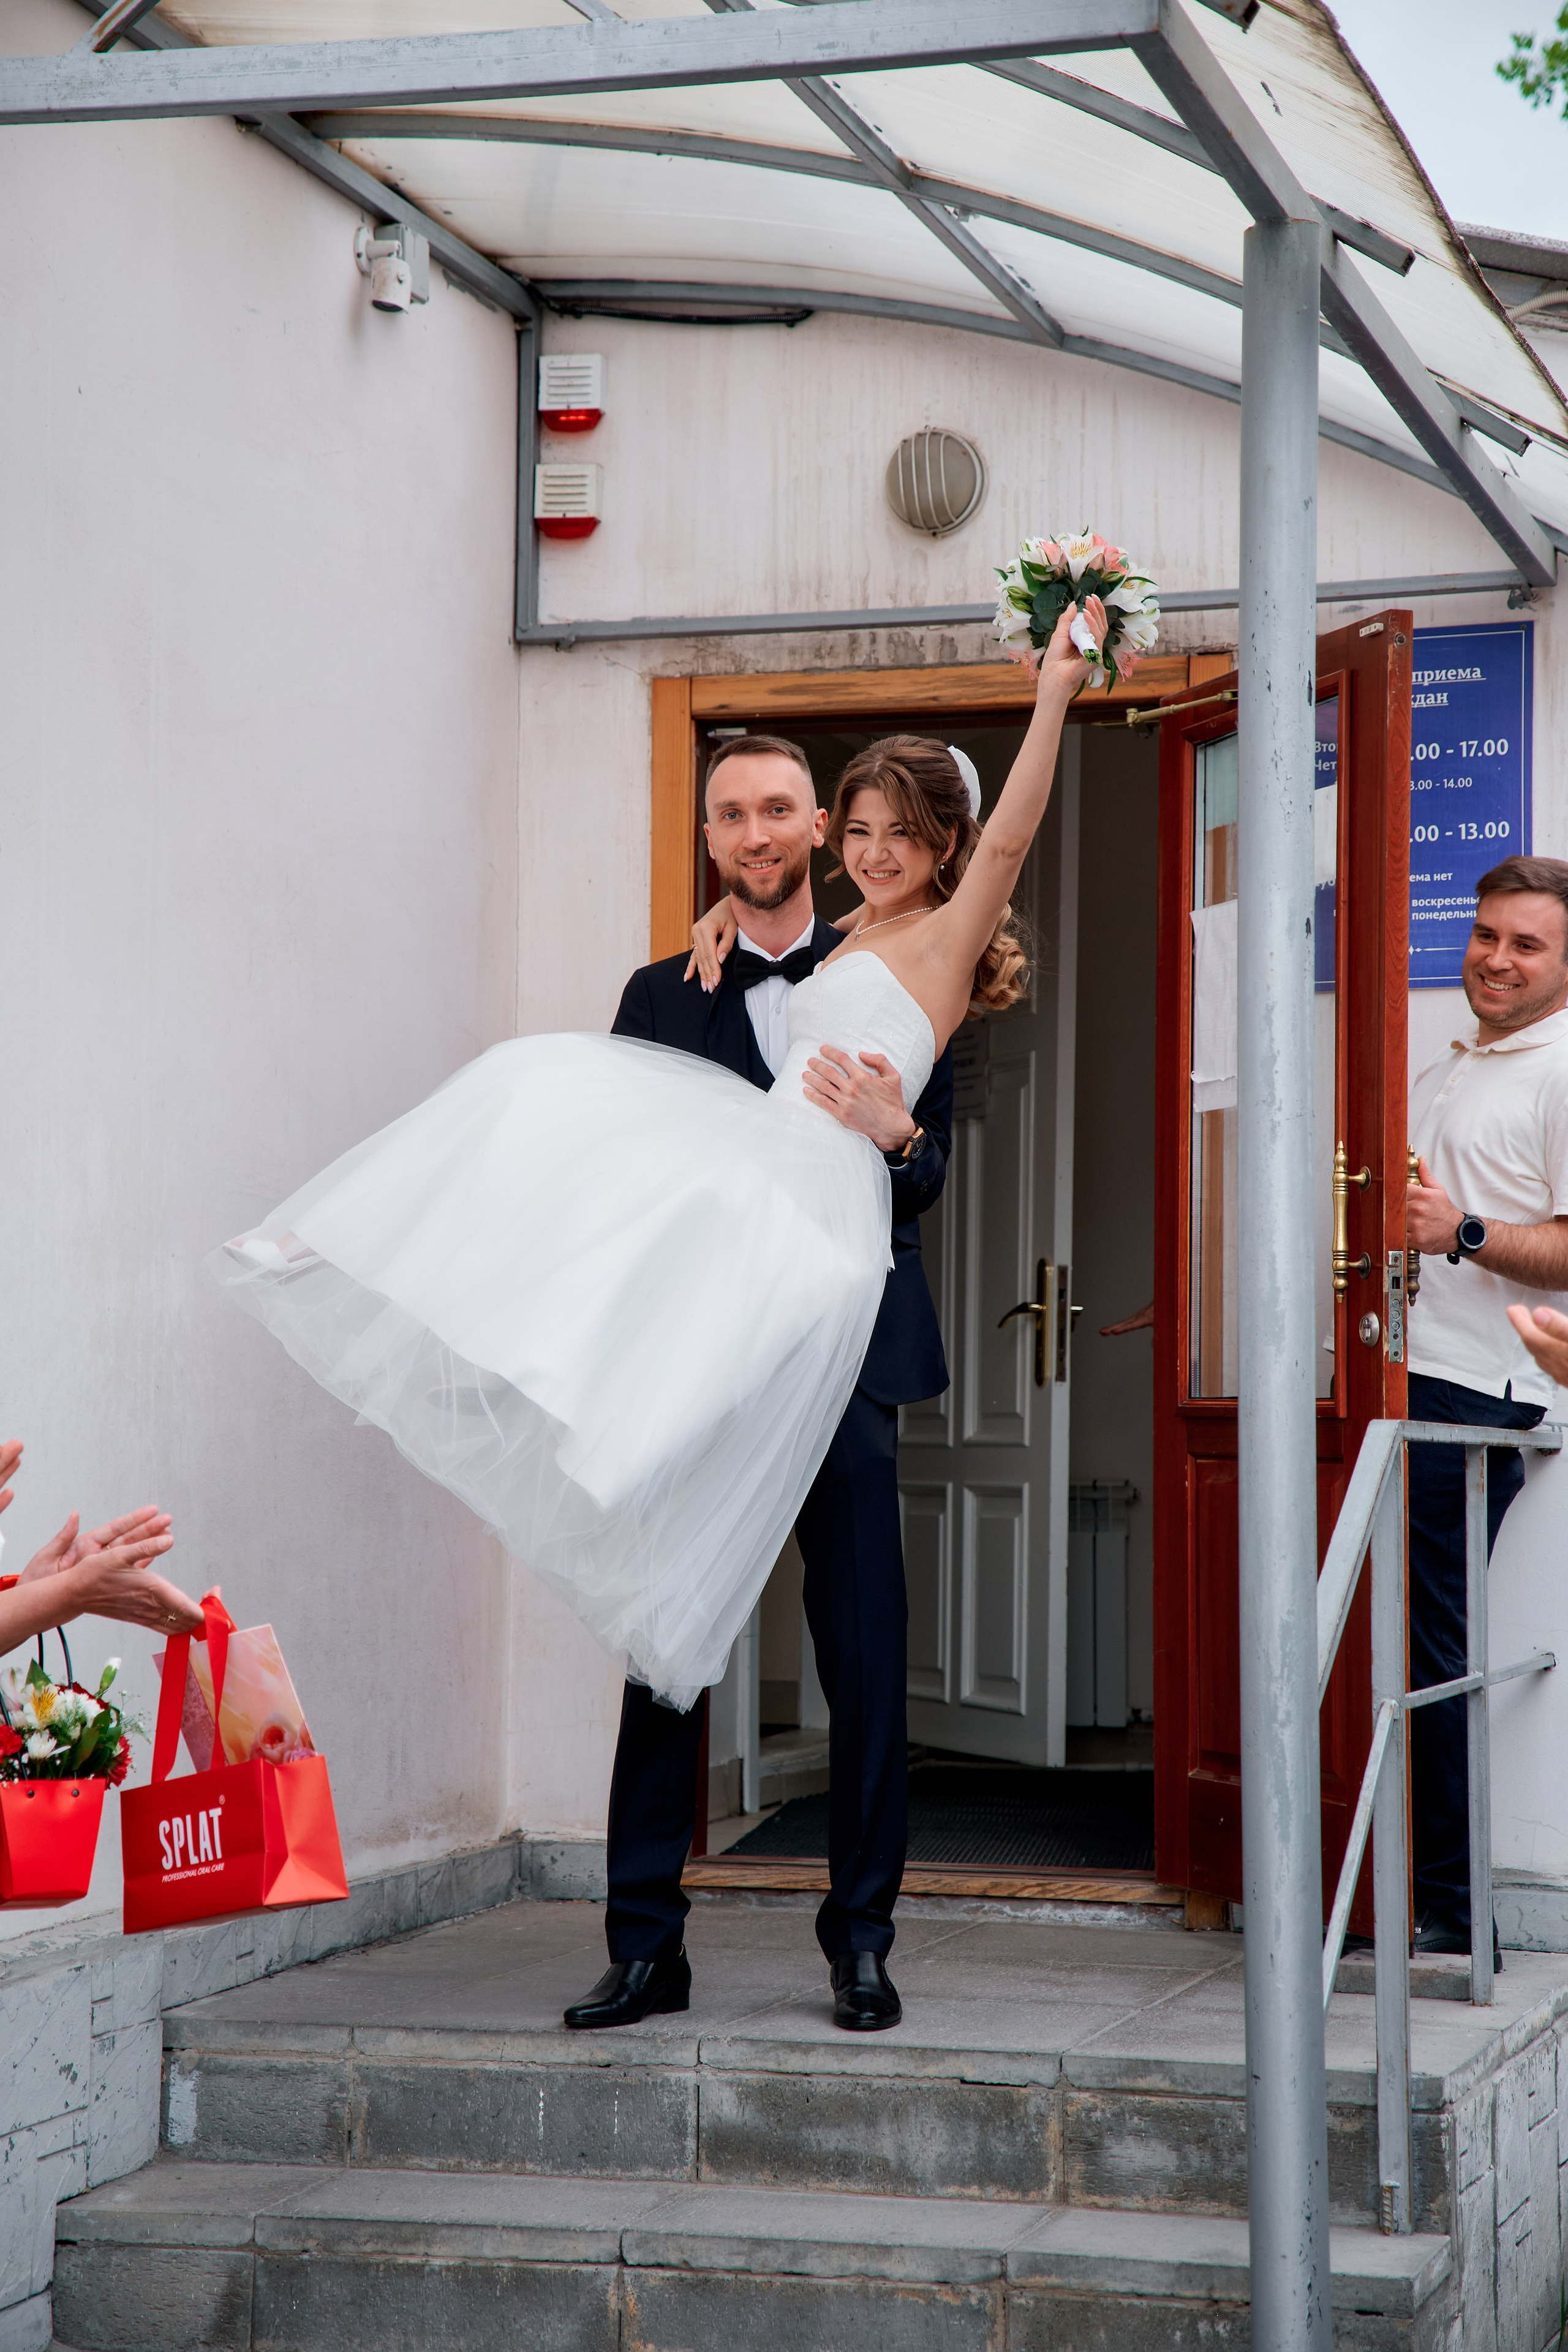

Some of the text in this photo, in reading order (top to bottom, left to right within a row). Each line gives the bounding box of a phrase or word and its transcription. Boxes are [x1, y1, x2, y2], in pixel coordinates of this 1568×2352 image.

[1411, 667, 1482, 686] приема
[1315, 741, 1338, 755] Вто
[1459, 739, 1509, 758] 17.00
[1442, 777, 1472, 789] 14.00
[1458, 821, 1510, 840] 13.00
[159, 1807, 222, 1871] SPLAT
[162, 1863, 225, 1883] PROFESSIONAL ORAL CARE
